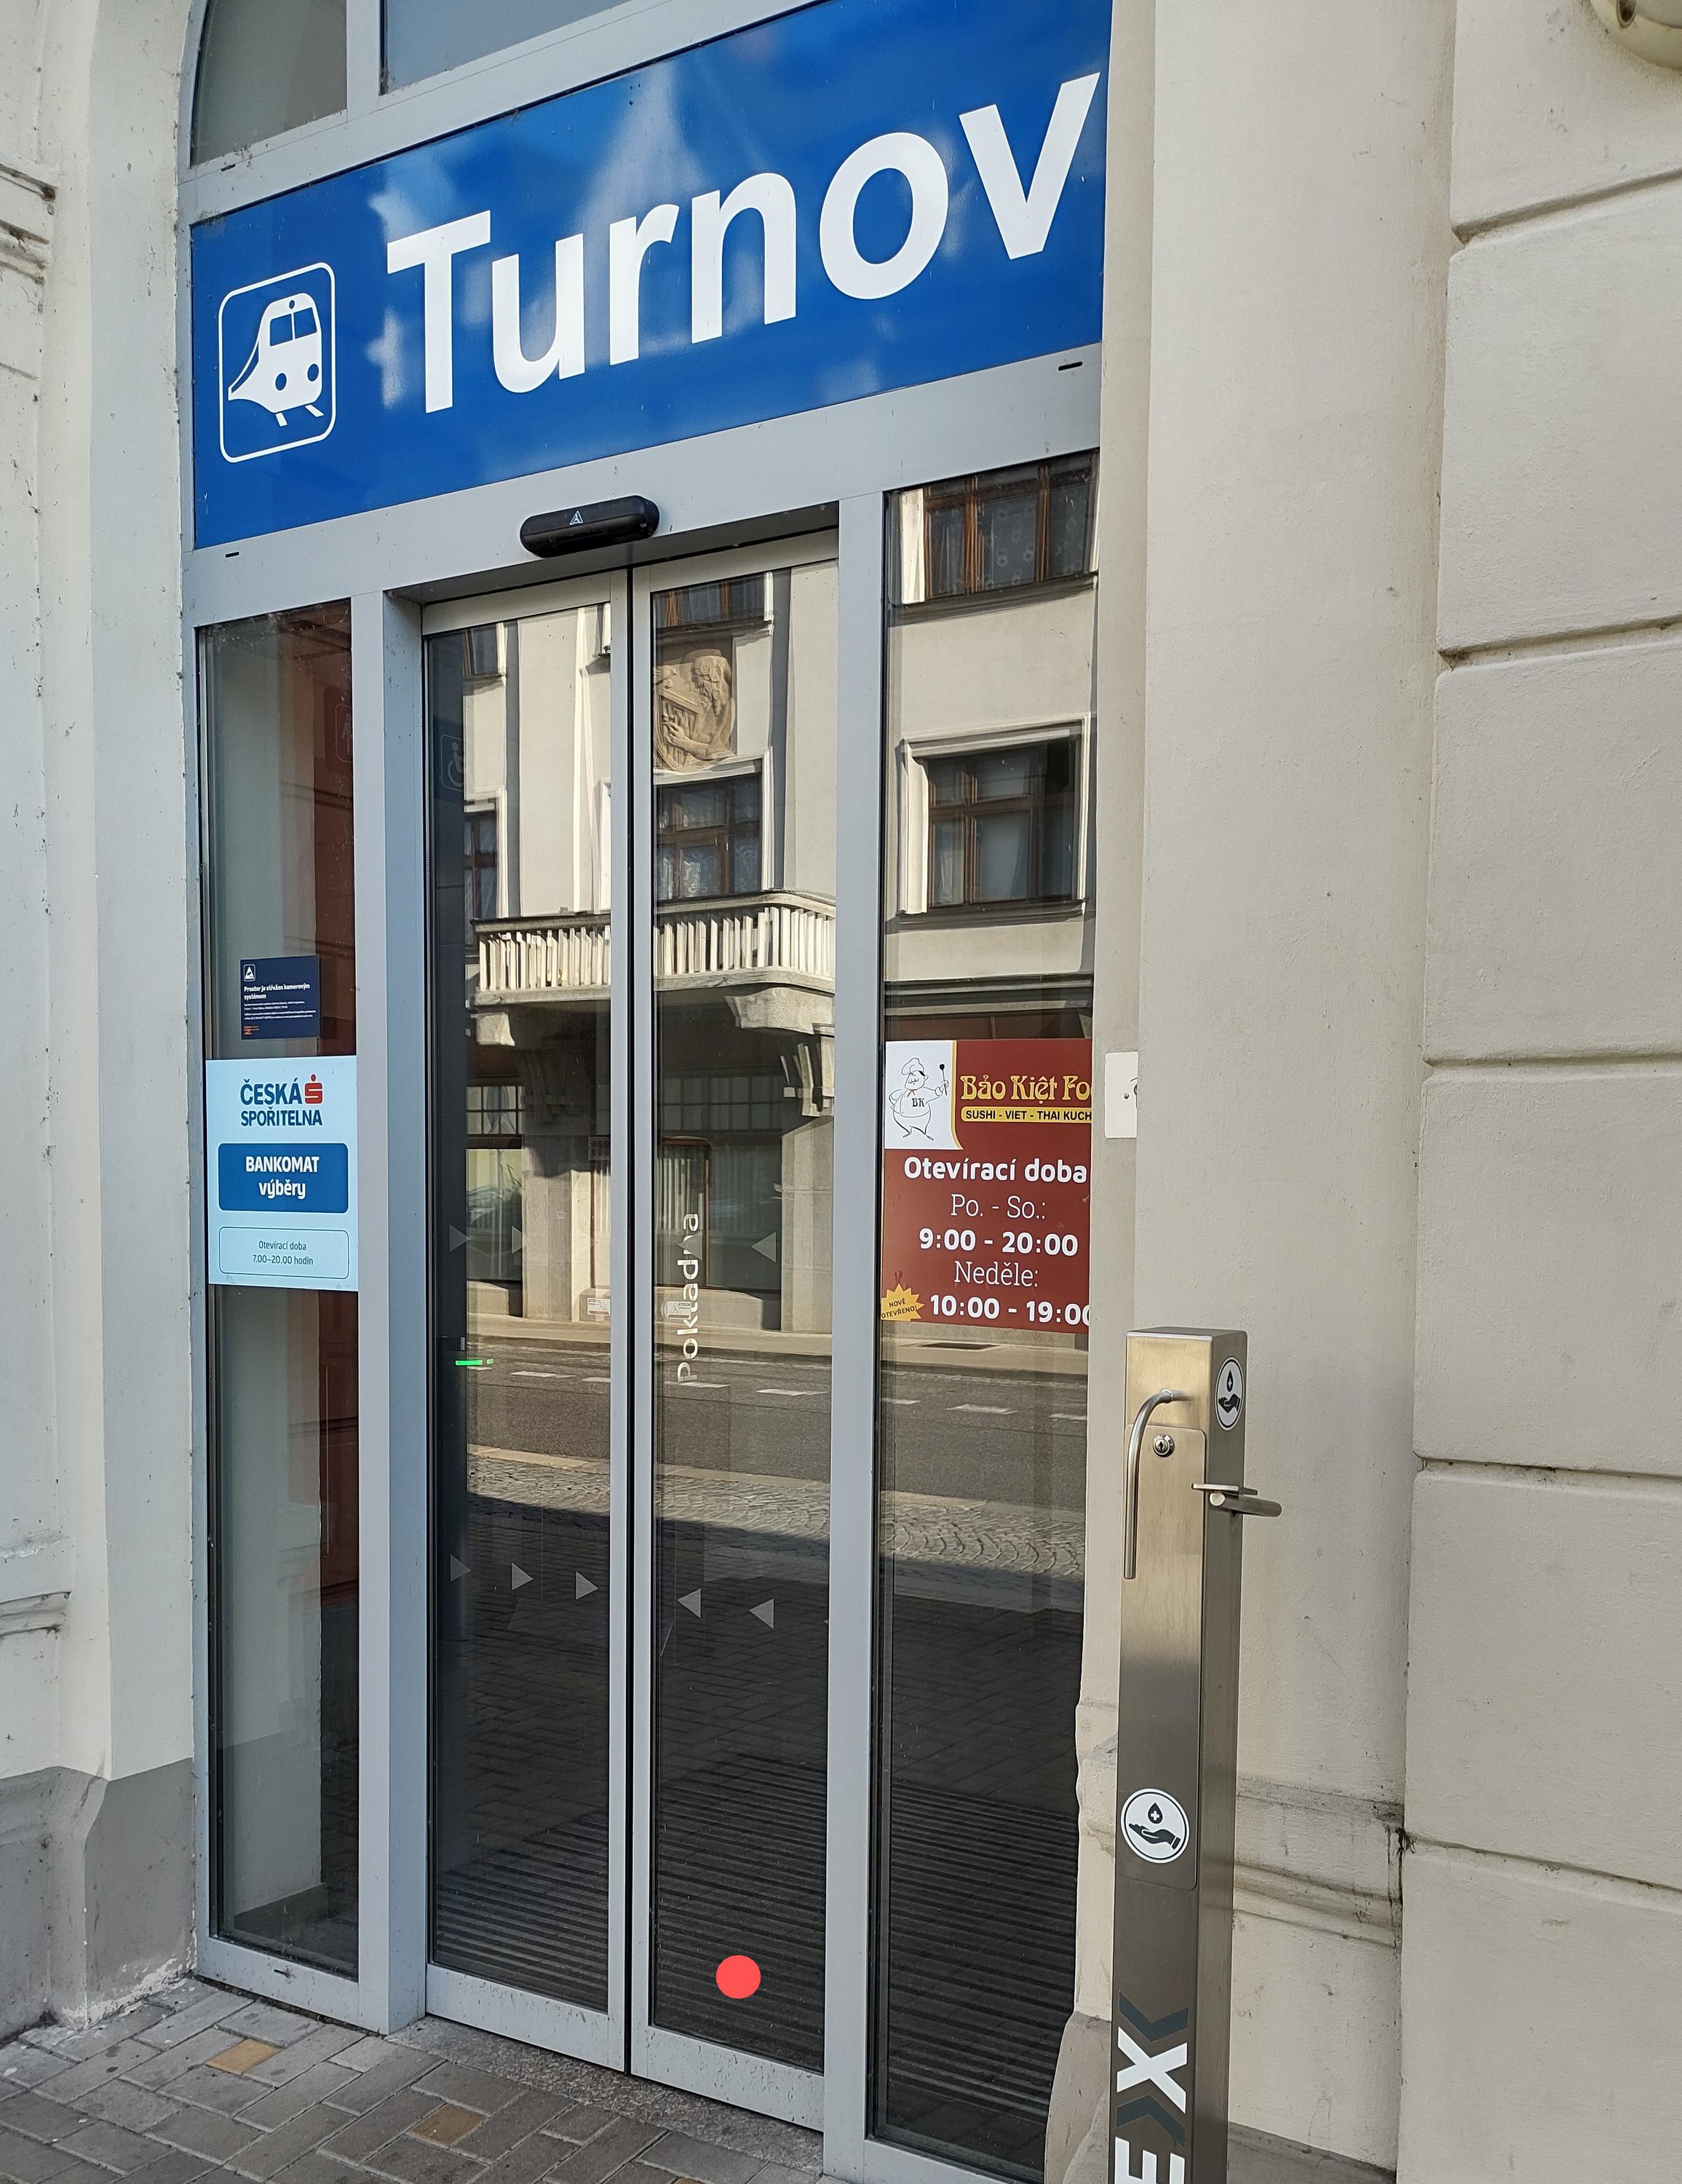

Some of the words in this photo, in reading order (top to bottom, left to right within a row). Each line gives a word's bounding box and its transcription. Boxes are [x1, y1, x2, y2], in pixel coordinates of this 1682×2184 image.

[387, 71, 1100, 414] Turnov
[240, 1077, 303, 1105] ČESKÁ
[960, 1074, 1007, 1101] Bảo
[1010, 1075, 1058, 1104] Kiệt
[1062, 1075, 1092, 1101] Fo
[911, 1098, 925, 1107] BK
[966, 1110, 996, 1120] SUSHI
[1005, 1110, 1027, 1120] VIET
[1036, 1110, 1060, 1120] THAI
[241, 1107, 322, 1126] SPOŘITELNA
[245, 1156, 320, 1173] BANKOMAT
[904, 1156, 1016, 1181] Otevírací
[1024, 1159, 1087, 1183] doba
[258, 1179, 306, 1200] výběry
[950, 1194, 983, 1216] Po.
[1007, 1195, 1046, 1219] So.:
[258, 1240, 288, 1250] Otevírací
[290, 1241, 306, 1251] doba
[919, 1228, 976, 1251] 9:00
[1001, 1231, 1078, 1257] 20:00
[294, 1256, 314, 1266] hodin
[954, 1260, 1039, 1287] Neděle:
[930, 1294, 1000, 1320] 10:00
